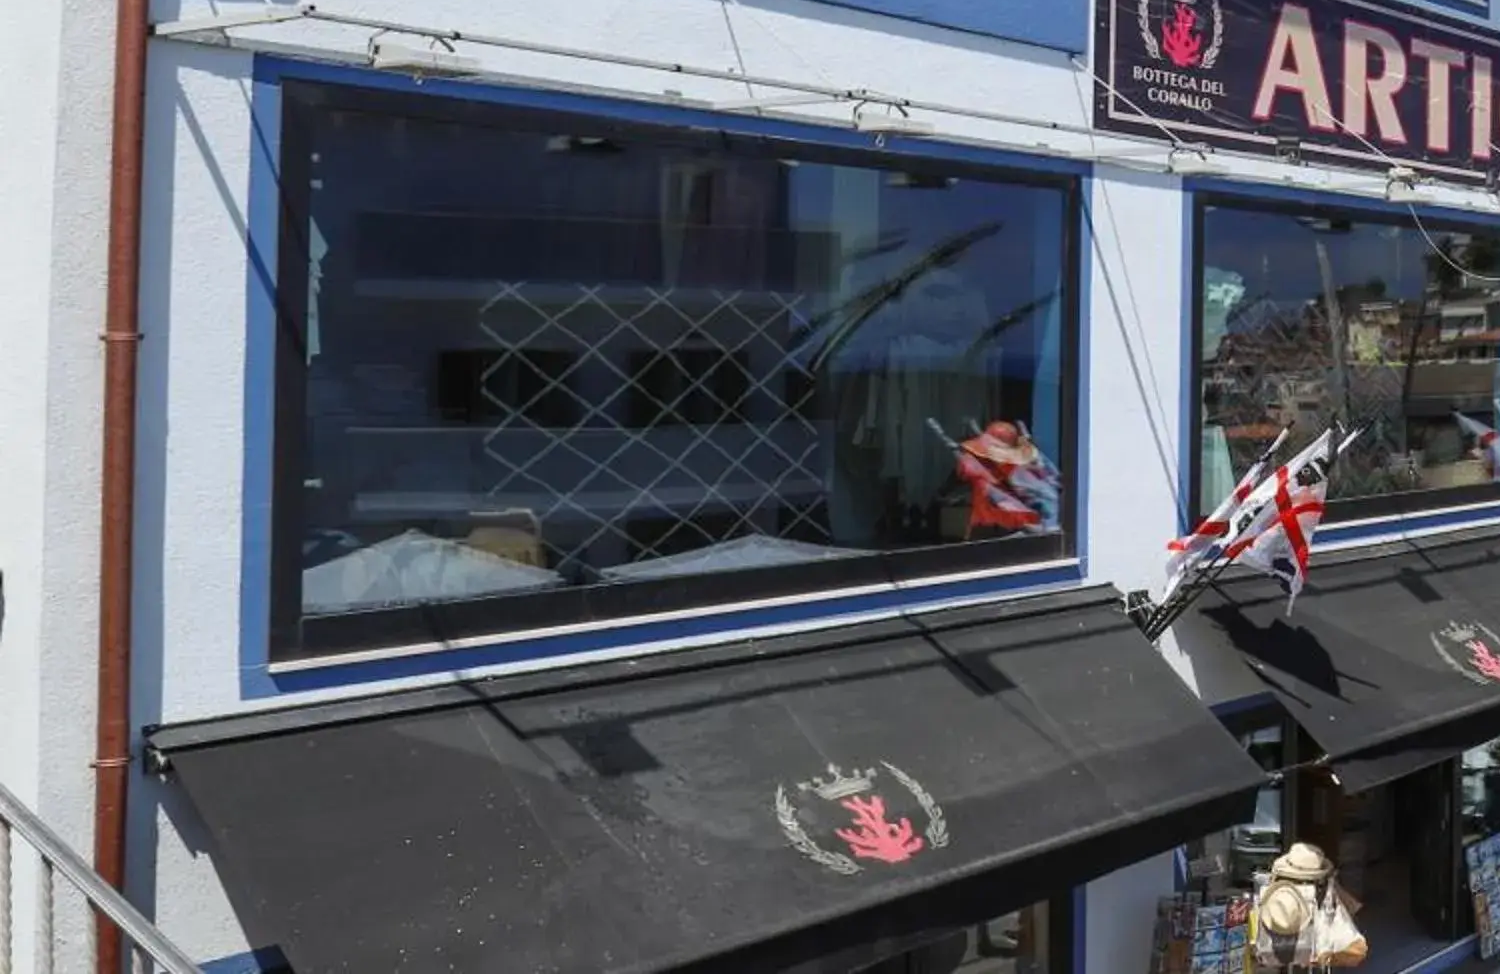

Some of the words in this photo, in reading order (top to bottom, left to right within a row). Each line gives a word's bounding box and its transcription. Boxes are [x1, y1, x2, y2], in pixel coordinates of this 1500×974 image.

[1133, 66, 1198, 90] BOTTEGA
[1201, 79, 1227, 97] DEL
[1147, 87, 1212, 110] CORALLO
